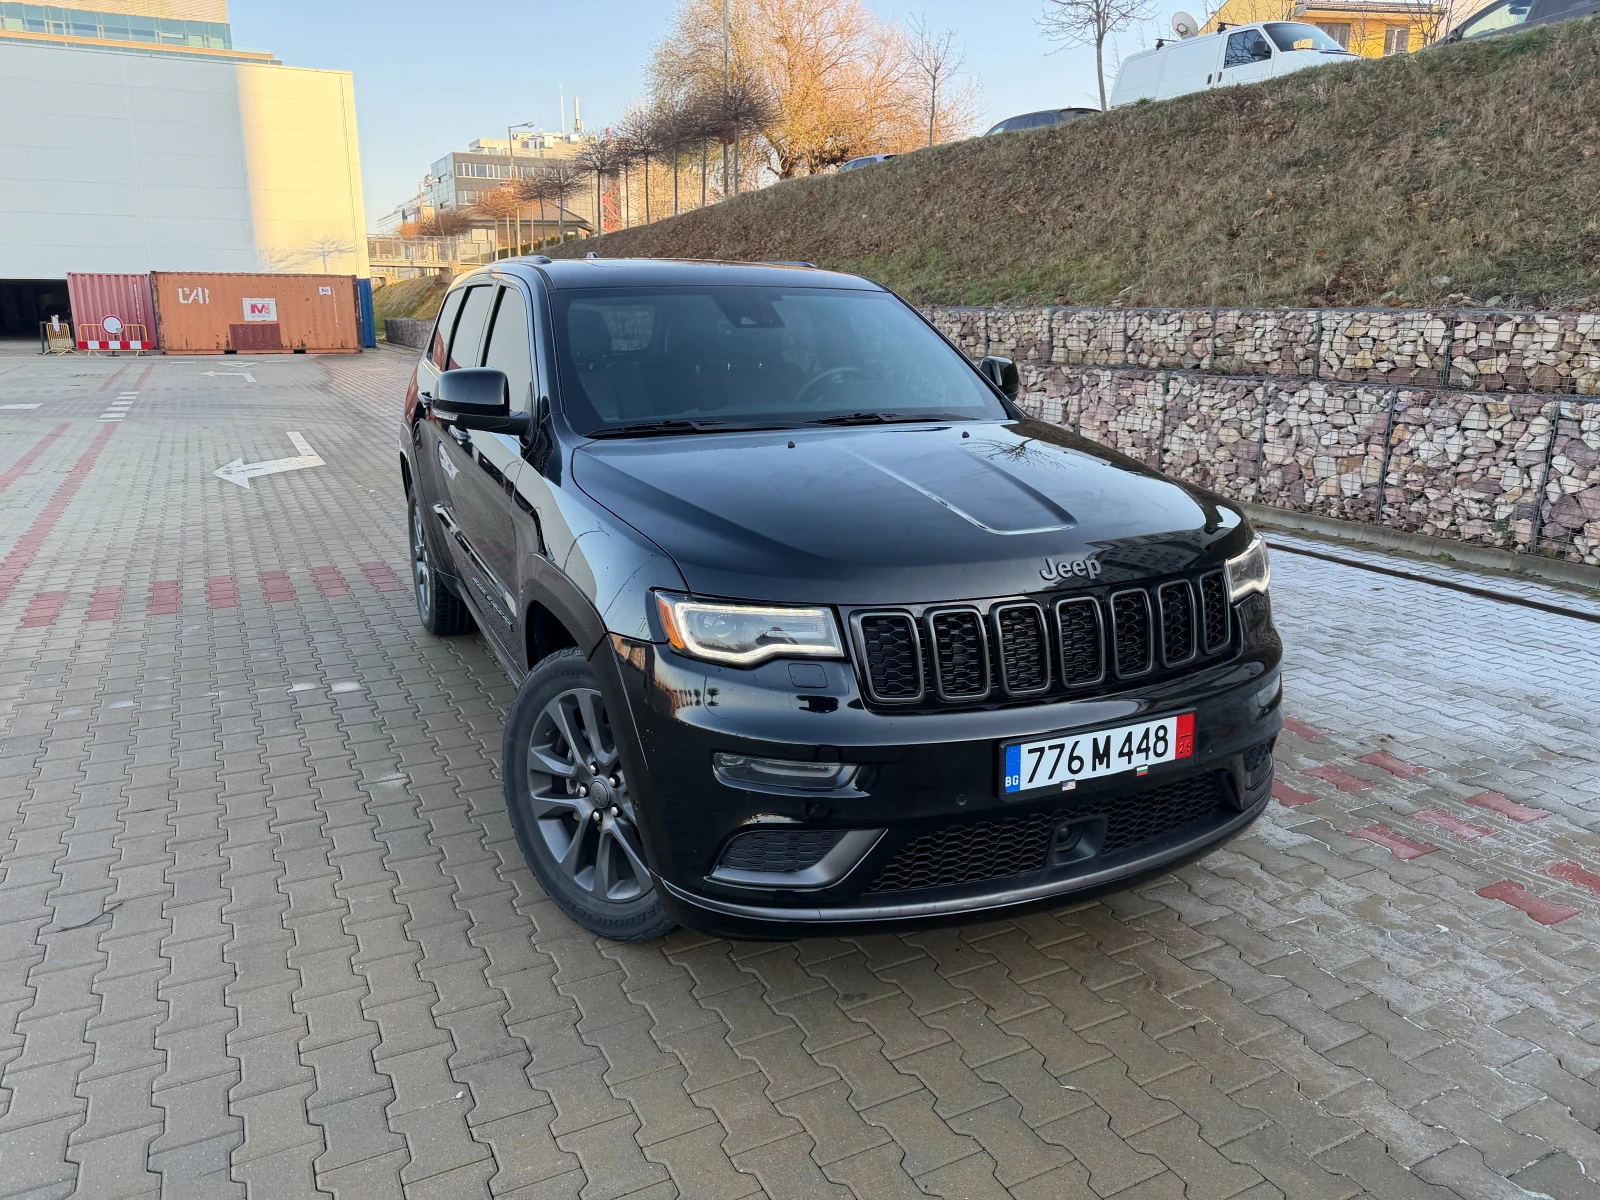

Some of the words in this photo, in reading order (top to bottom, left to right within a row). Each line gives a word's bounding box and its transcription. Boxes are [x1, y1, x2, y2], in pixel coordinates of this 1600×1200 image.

[1039, 558, 1101, 581] Jeep
[1027, 740, 1084, 783] 776
[1091, 735, 1111, 772] M
[1118, 724, 1169, 765] 448
[1179, 741, 1192, 755] 25
[1005, 774, 1019, 788] BG
